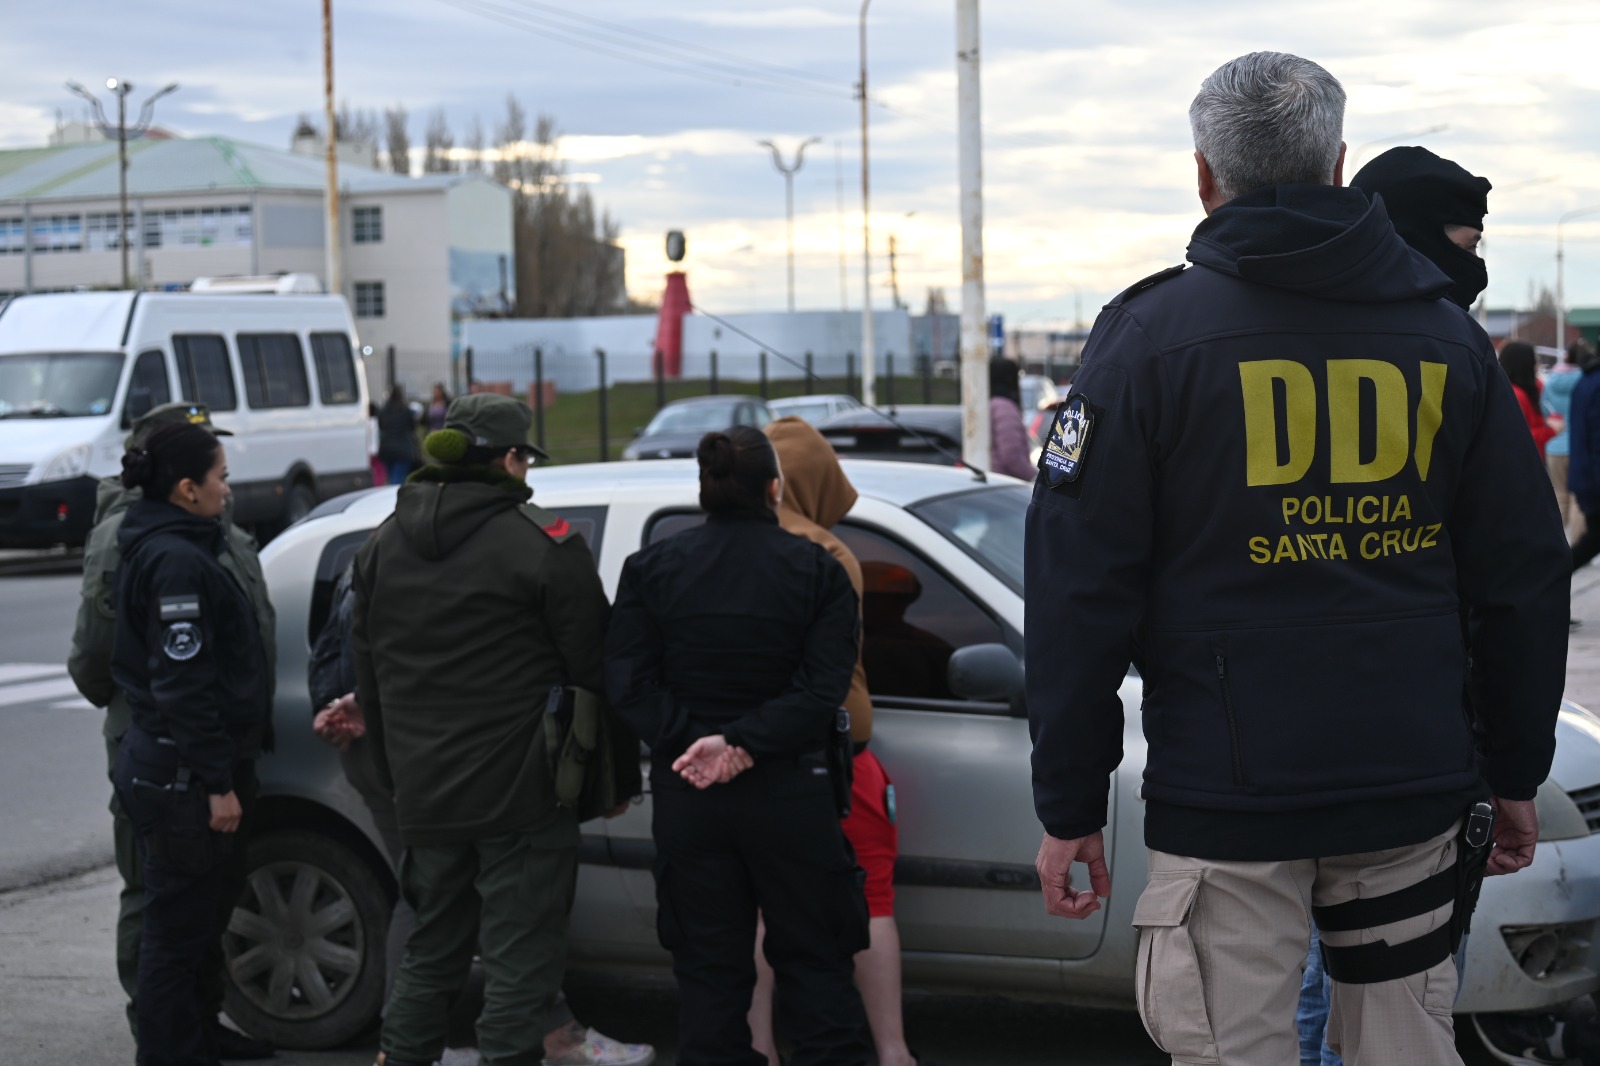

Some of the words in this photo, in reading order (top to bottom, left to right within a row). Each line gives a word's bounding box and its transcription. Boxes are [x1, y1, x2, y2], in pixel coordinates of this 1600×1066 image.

[1238, 358, 1448, 486] DDI
[1045, 459, 1059, 469] SANTA
[1282, 495, 1411, 524] POLICIA
[1248, 532, 1348, 563] SANTA
[1359, 522, 1442, 559] CRUZ
